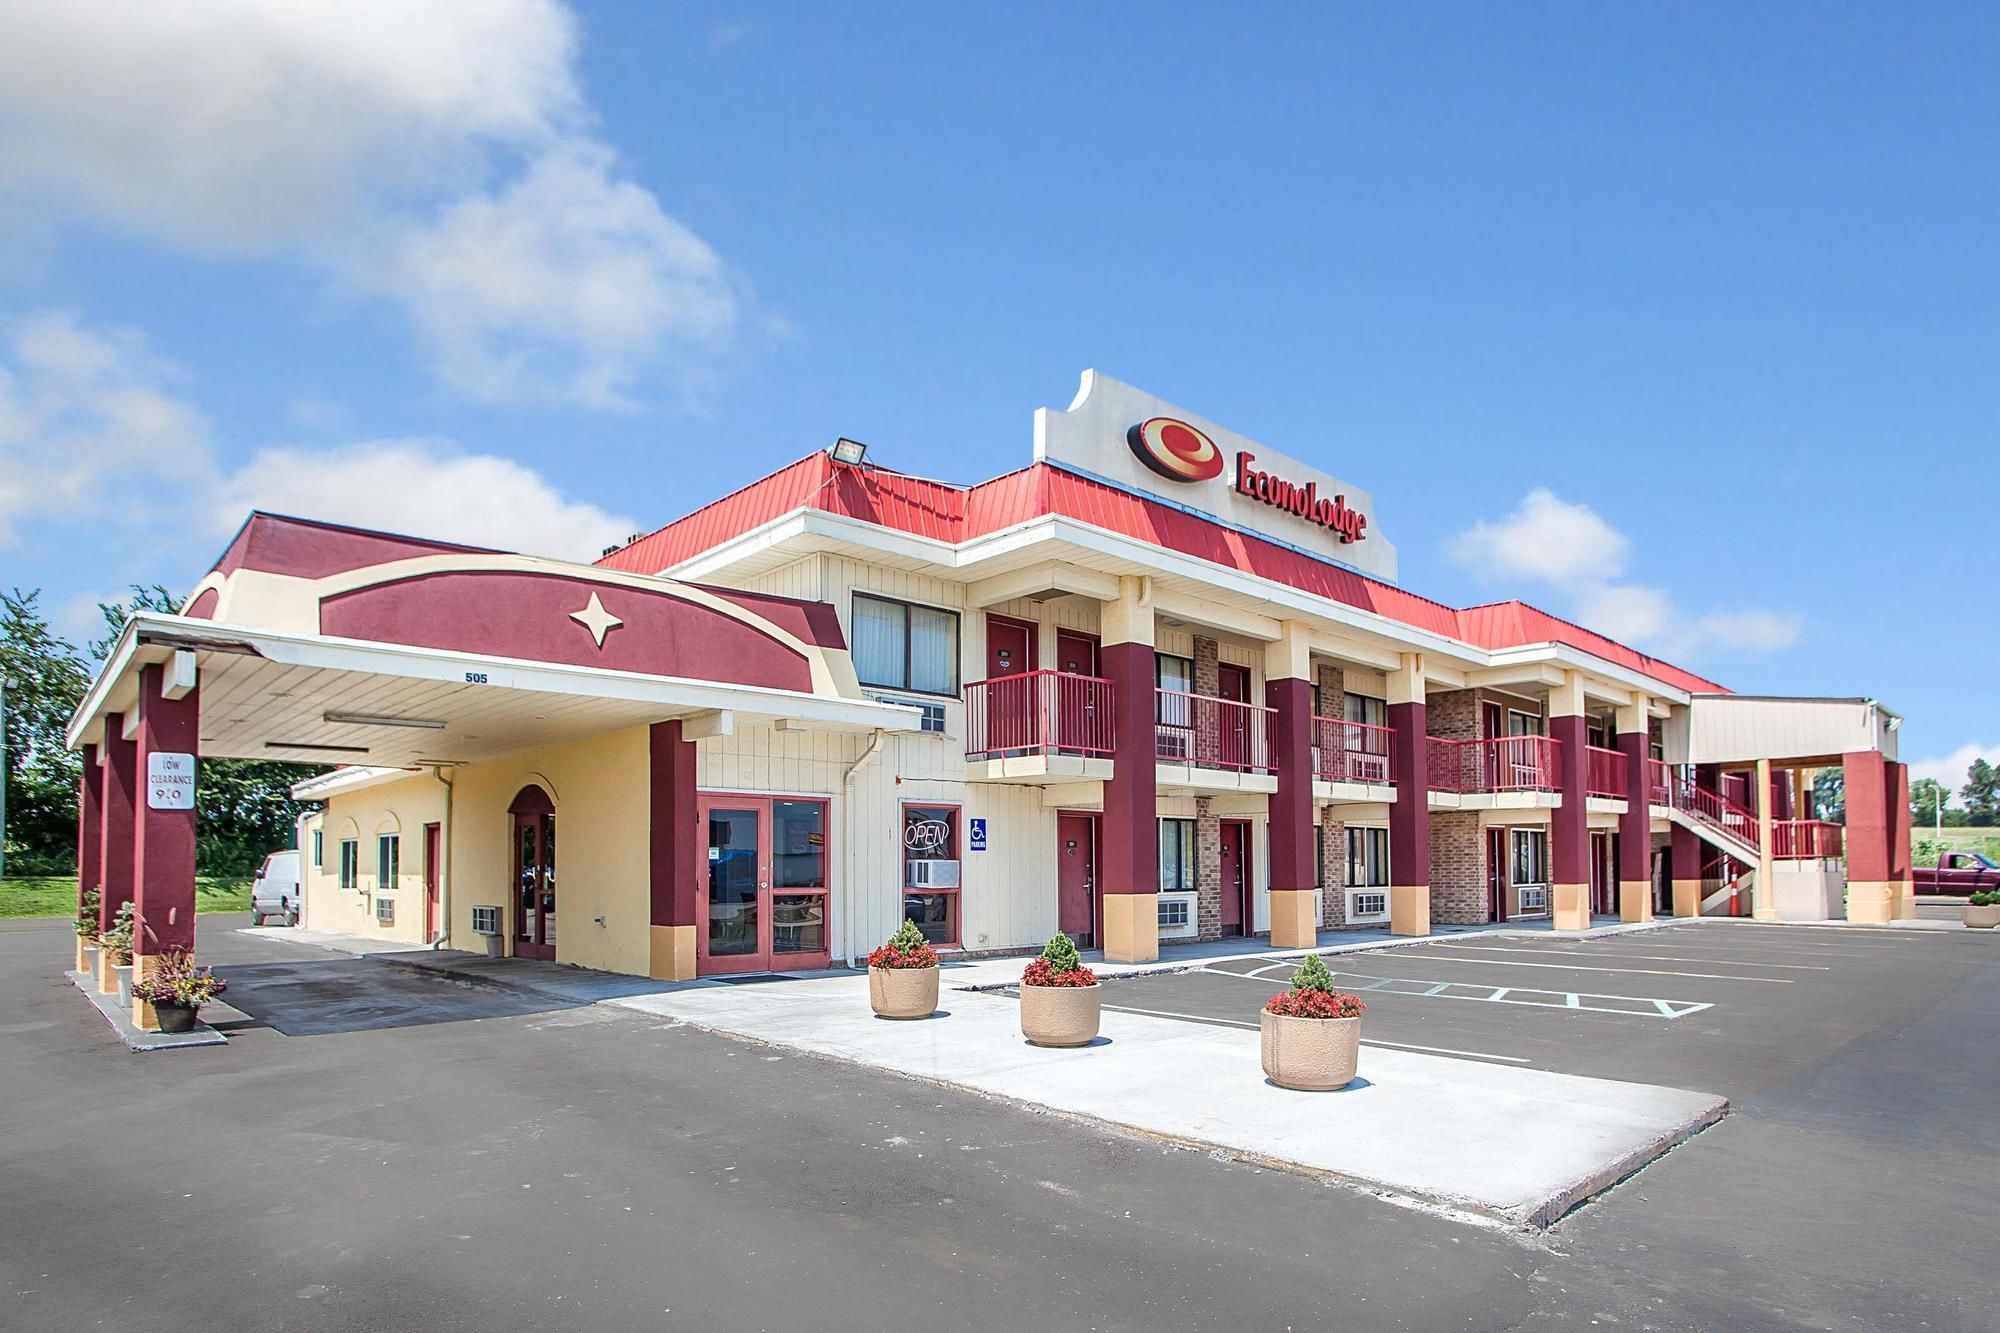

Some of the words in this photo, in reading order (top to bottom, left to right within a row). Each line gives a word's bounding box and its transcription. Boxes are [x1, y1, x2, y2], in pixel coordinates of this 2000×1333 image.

[465, 672, 488, 684] 505
[163, 760, 181, 770] LOW
[151, 774, 193, 785] CLEARANCE
[905, 825, 946, 845] OPEN
